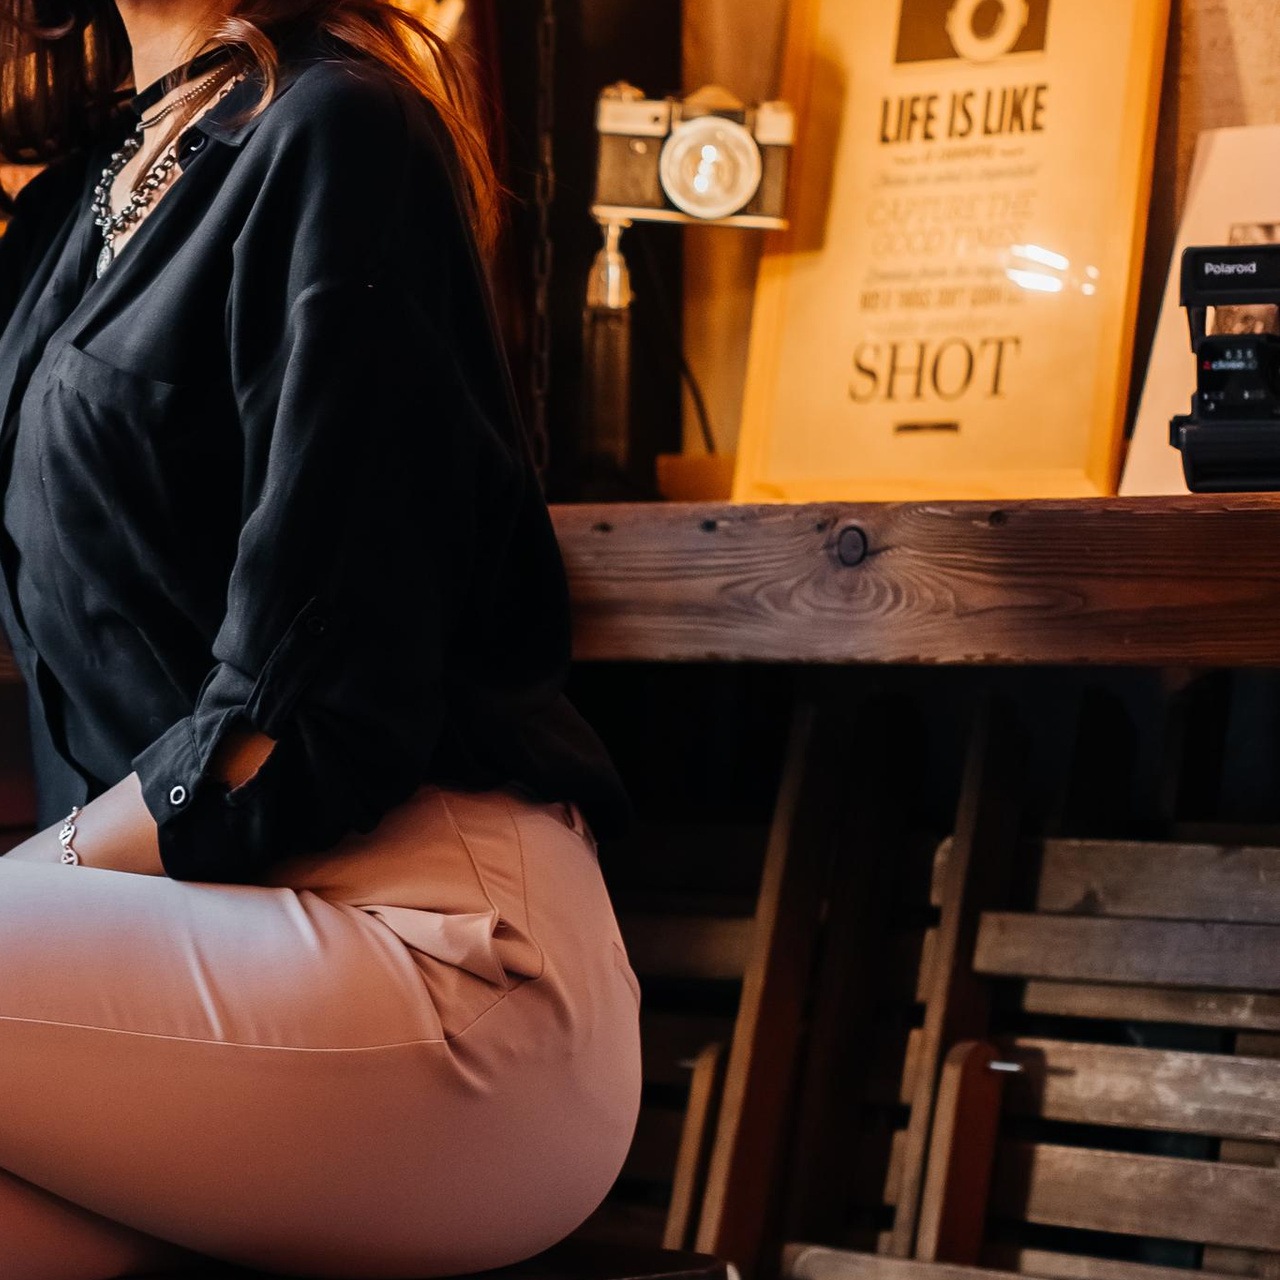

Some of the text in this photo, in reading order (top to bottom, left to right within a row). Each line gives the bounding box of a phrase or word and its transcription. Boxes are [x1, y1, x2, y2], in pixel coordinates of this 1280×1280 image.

[879, 83, 1049, 144] LIFE IS LIKE
[1203, 261, 1257, 277] Polaroid
[847, 333, 1022, 405] SHOT
